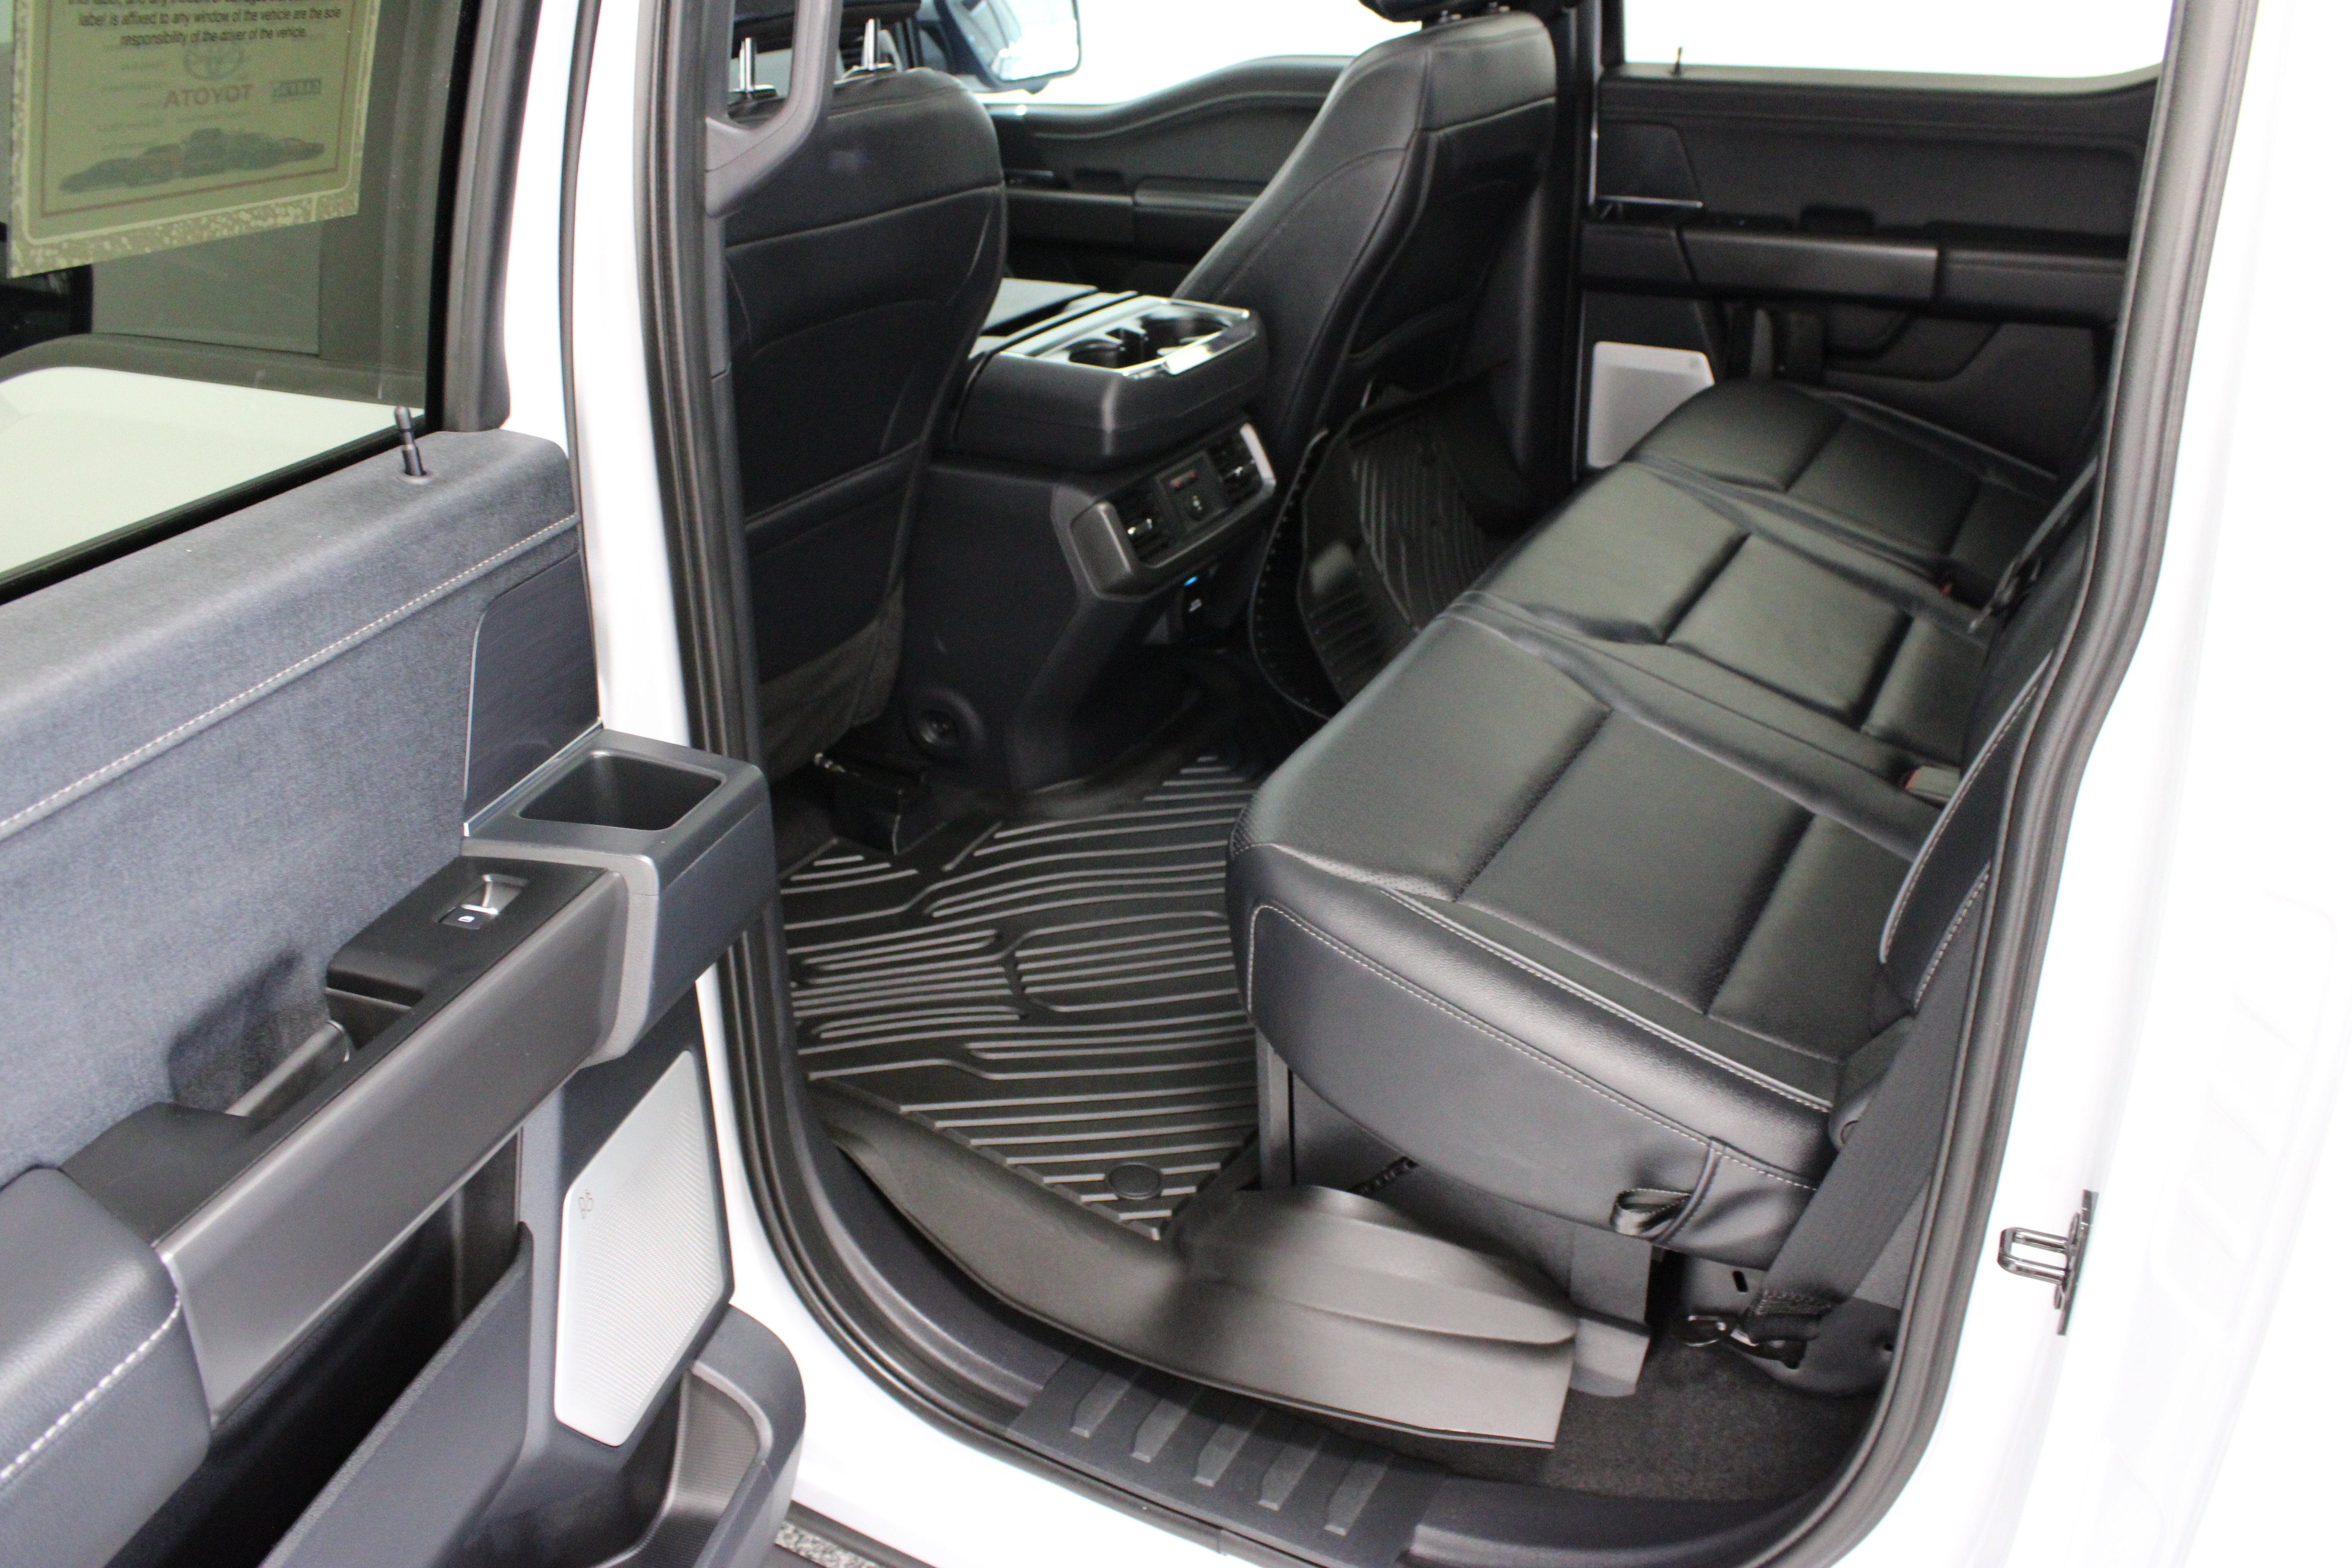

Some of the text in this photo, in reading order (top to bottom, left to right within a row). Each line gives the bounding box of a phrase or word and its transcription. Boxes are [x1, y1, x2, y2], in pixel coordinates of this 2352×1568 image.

[173, 13, 189, 27] any
[194, 9, 229, 23] window
[231, 9, 243, 22] of
[243, 9, 258, 21] the
[260, 9, 291, 20] vehicle
[293, 9, 307, 20] are
[309, 7, 323, 19] the
[325, 6, 341, 19] sole
[120, 30, 186, 47] responsibility
[190, 29, 201, 43] of
[202, 29, 218, 42] the
[220, 28, 246, 42] driver
[248, 27, 259, 40] of
[260, 27, 274, 40] the
